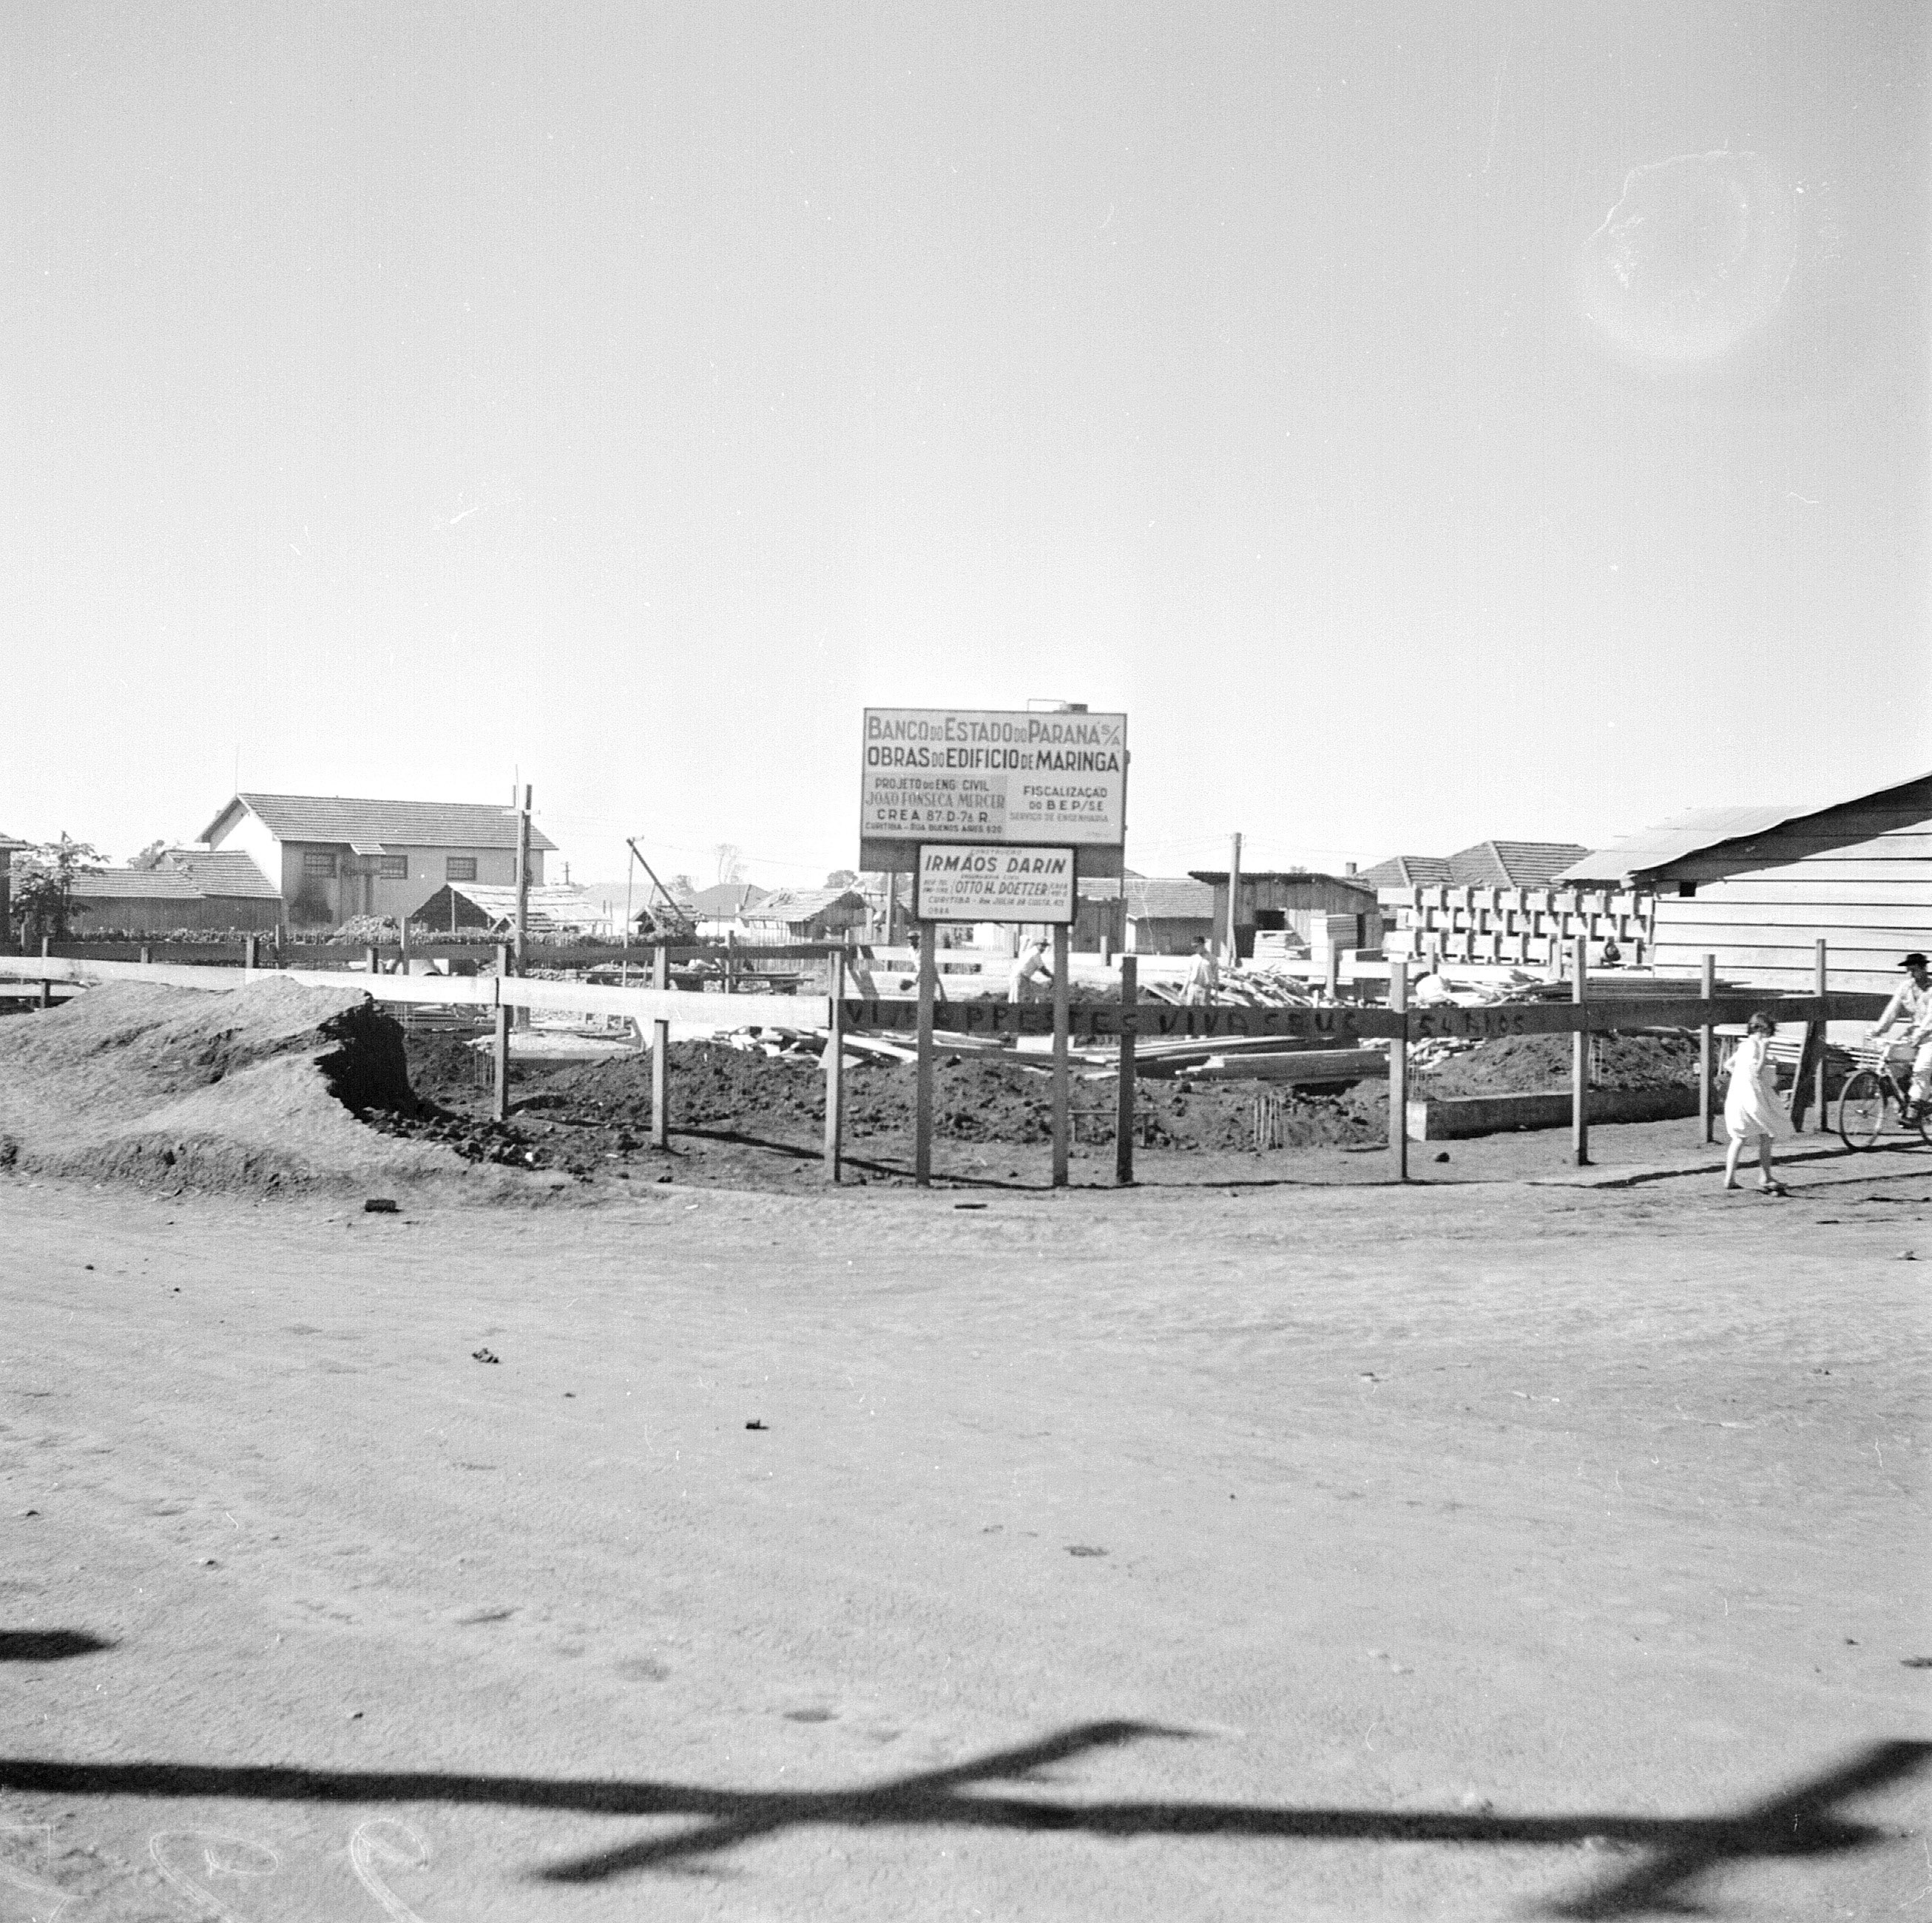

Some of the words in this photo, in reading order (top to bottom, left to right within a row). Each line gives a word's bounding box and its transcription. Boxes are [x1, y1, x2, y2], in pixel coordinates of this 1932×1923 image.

[868, 716, 929, 740] BANCO
[930, 726, 944, 741] DO
[945, 717, 1013, 743] ESTADO
[1101, 724, 1121, 746] S/A
[868, 746, 930, 767] OBRAS
[931, 751, 945, 768] DO
[947, 748, 1019, 769] EDIFICIO
[1021, 754, 1034, 770] DE
[875, 778, 922, 789] PROJETO
[962, 780, 989, 791] CIVIL
[959, 794, 1005, 808] MERCER
[865, 822, 902, 830] CURITIBA
[1006, 858, 1067, 873] DARIN
[955, 881, 983, 894] OTTO
[999, 882, 1048, 895] DOETZER
